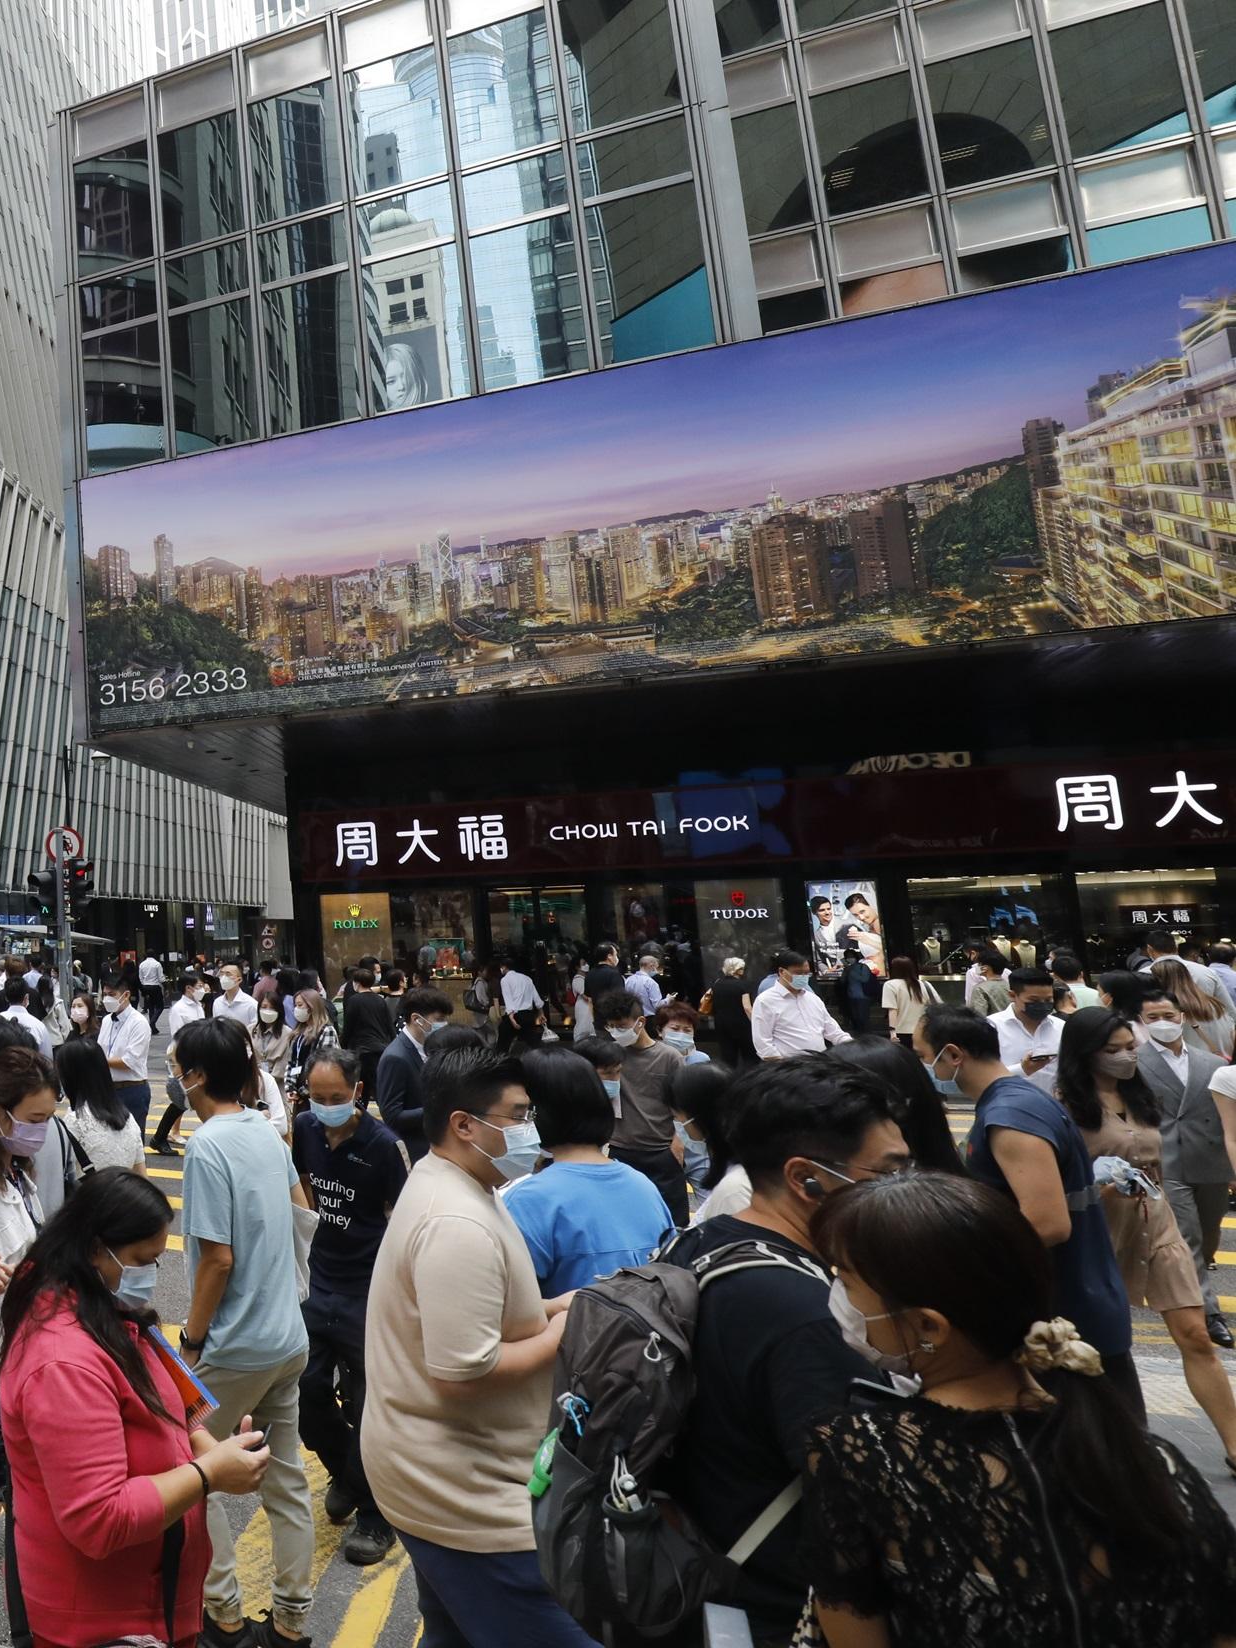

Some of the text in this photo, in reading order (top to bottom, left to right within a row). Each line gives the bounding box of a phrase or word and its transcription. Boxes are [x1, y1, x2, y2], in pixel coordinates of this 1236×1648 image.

[99, 670, 141, 682] Sales Hotline
[298, 673, 323, 682] CHEUNG
[341, 668, 371, 677] PROPERTY
[371, 662, 416, 673] DEVELOPMENT
[417, 659, 443, 668] LIMITED
[99, 667, 248, 706] 3156 2333
[1055, 770, 1224, 832] 周大
[549, 815, 750, 841] CHOW TAI FOOK
[335, 814, 509, 867] 周大福
[144, 904, 159, 912] LINKS
[710, 908, 769, 920] TUDOR
[1132, 909, 1190, 924] 周大福
[333, 919, 379, 929] ROLEX
[309, 1172, 355, 1202] Securing
[318, 1193, 343, 1209] your
